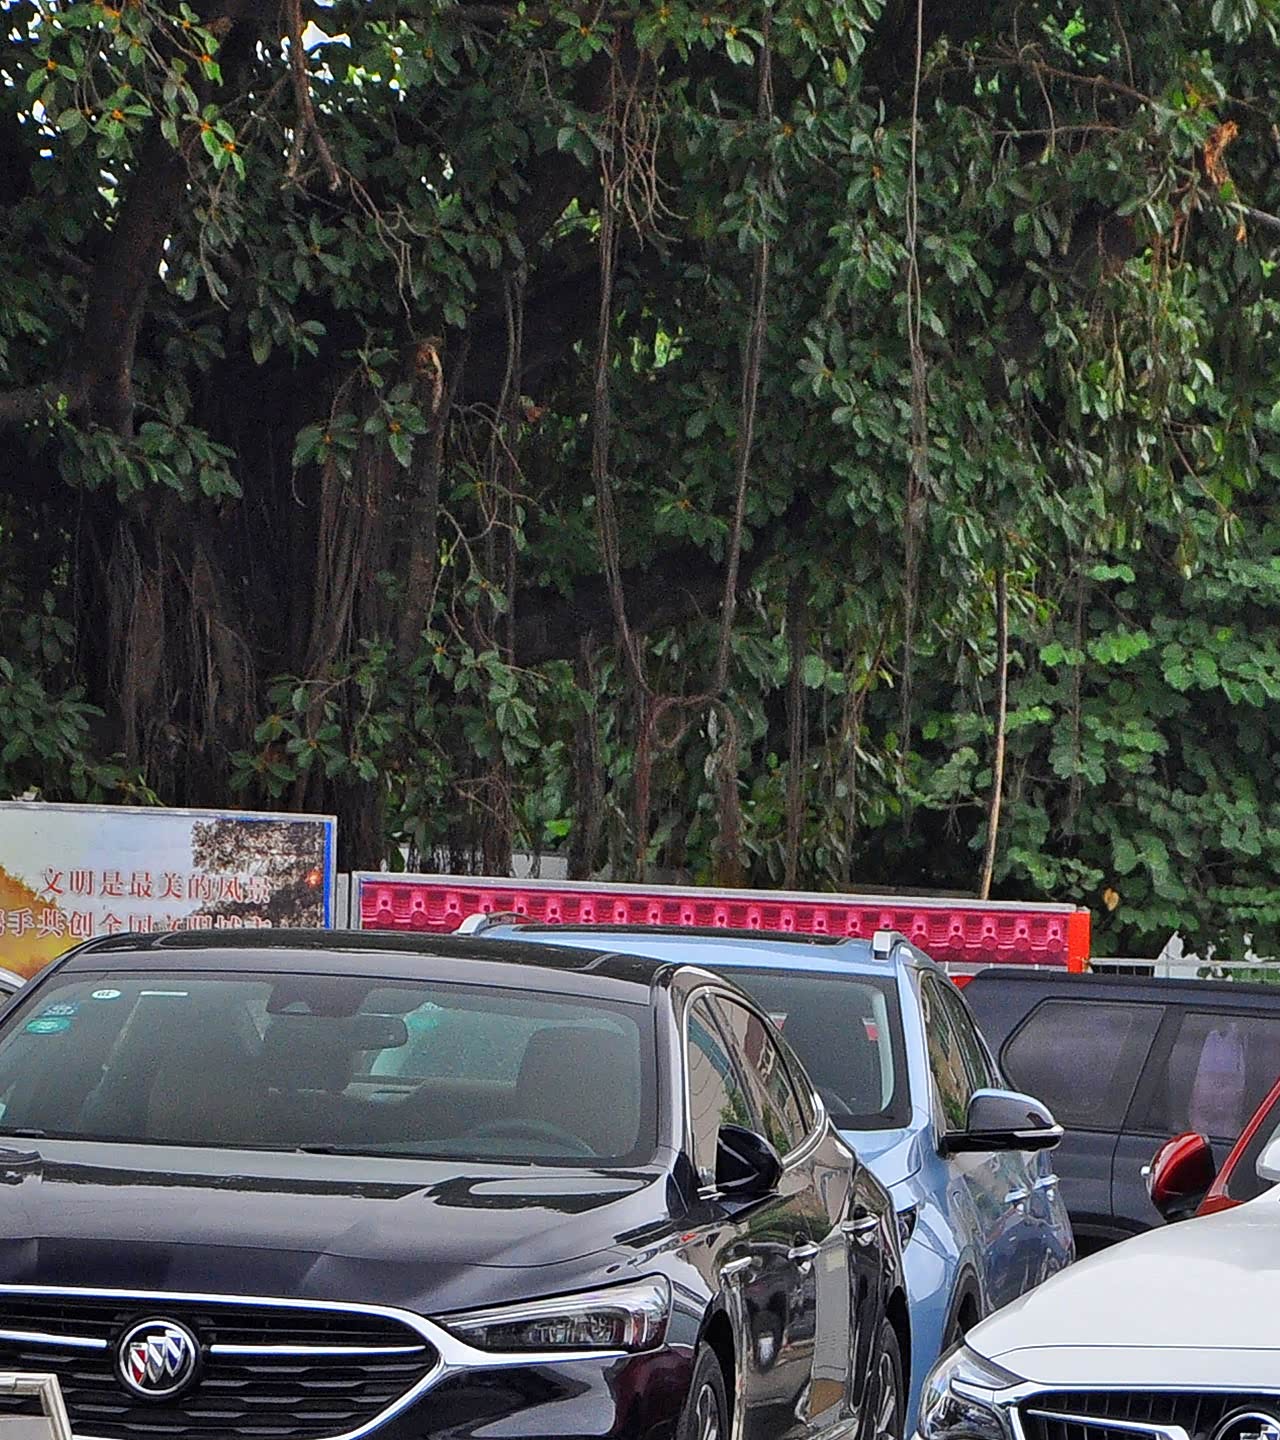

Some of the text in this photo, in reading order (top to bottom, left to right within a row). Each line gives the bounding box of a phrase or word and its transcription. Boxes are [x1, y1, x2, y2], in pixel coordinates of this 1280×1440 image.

[41, 866, 271, 903] 文明是最美的风景
